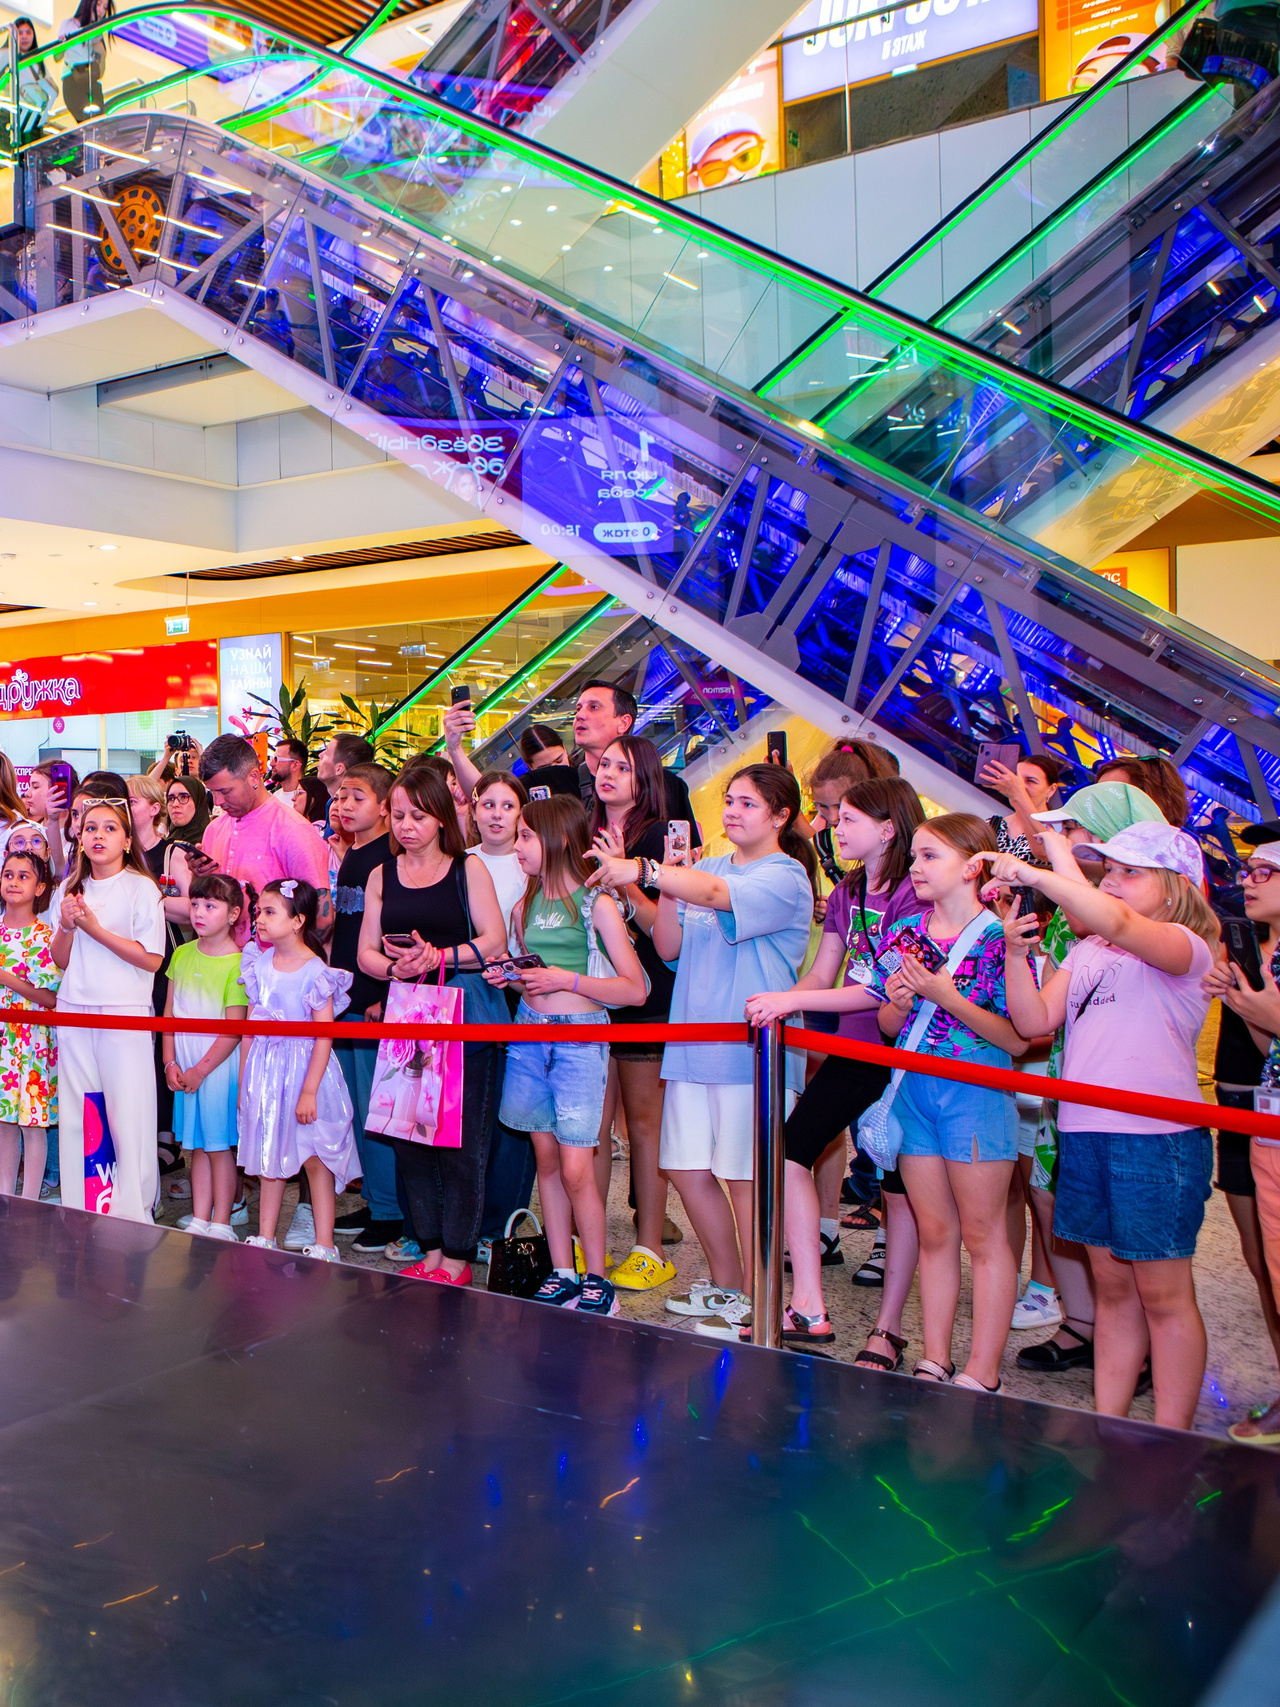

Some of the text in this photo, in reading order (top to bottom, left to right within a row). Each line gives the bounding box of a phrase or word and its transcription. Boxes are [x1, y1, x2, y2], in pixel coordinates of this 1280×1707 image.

[892, 29, 927, 57] ЭТАЖ
[230, 644, 272, 661] УЗНАЙ
[230, 661, 272, 676] НАШИ
